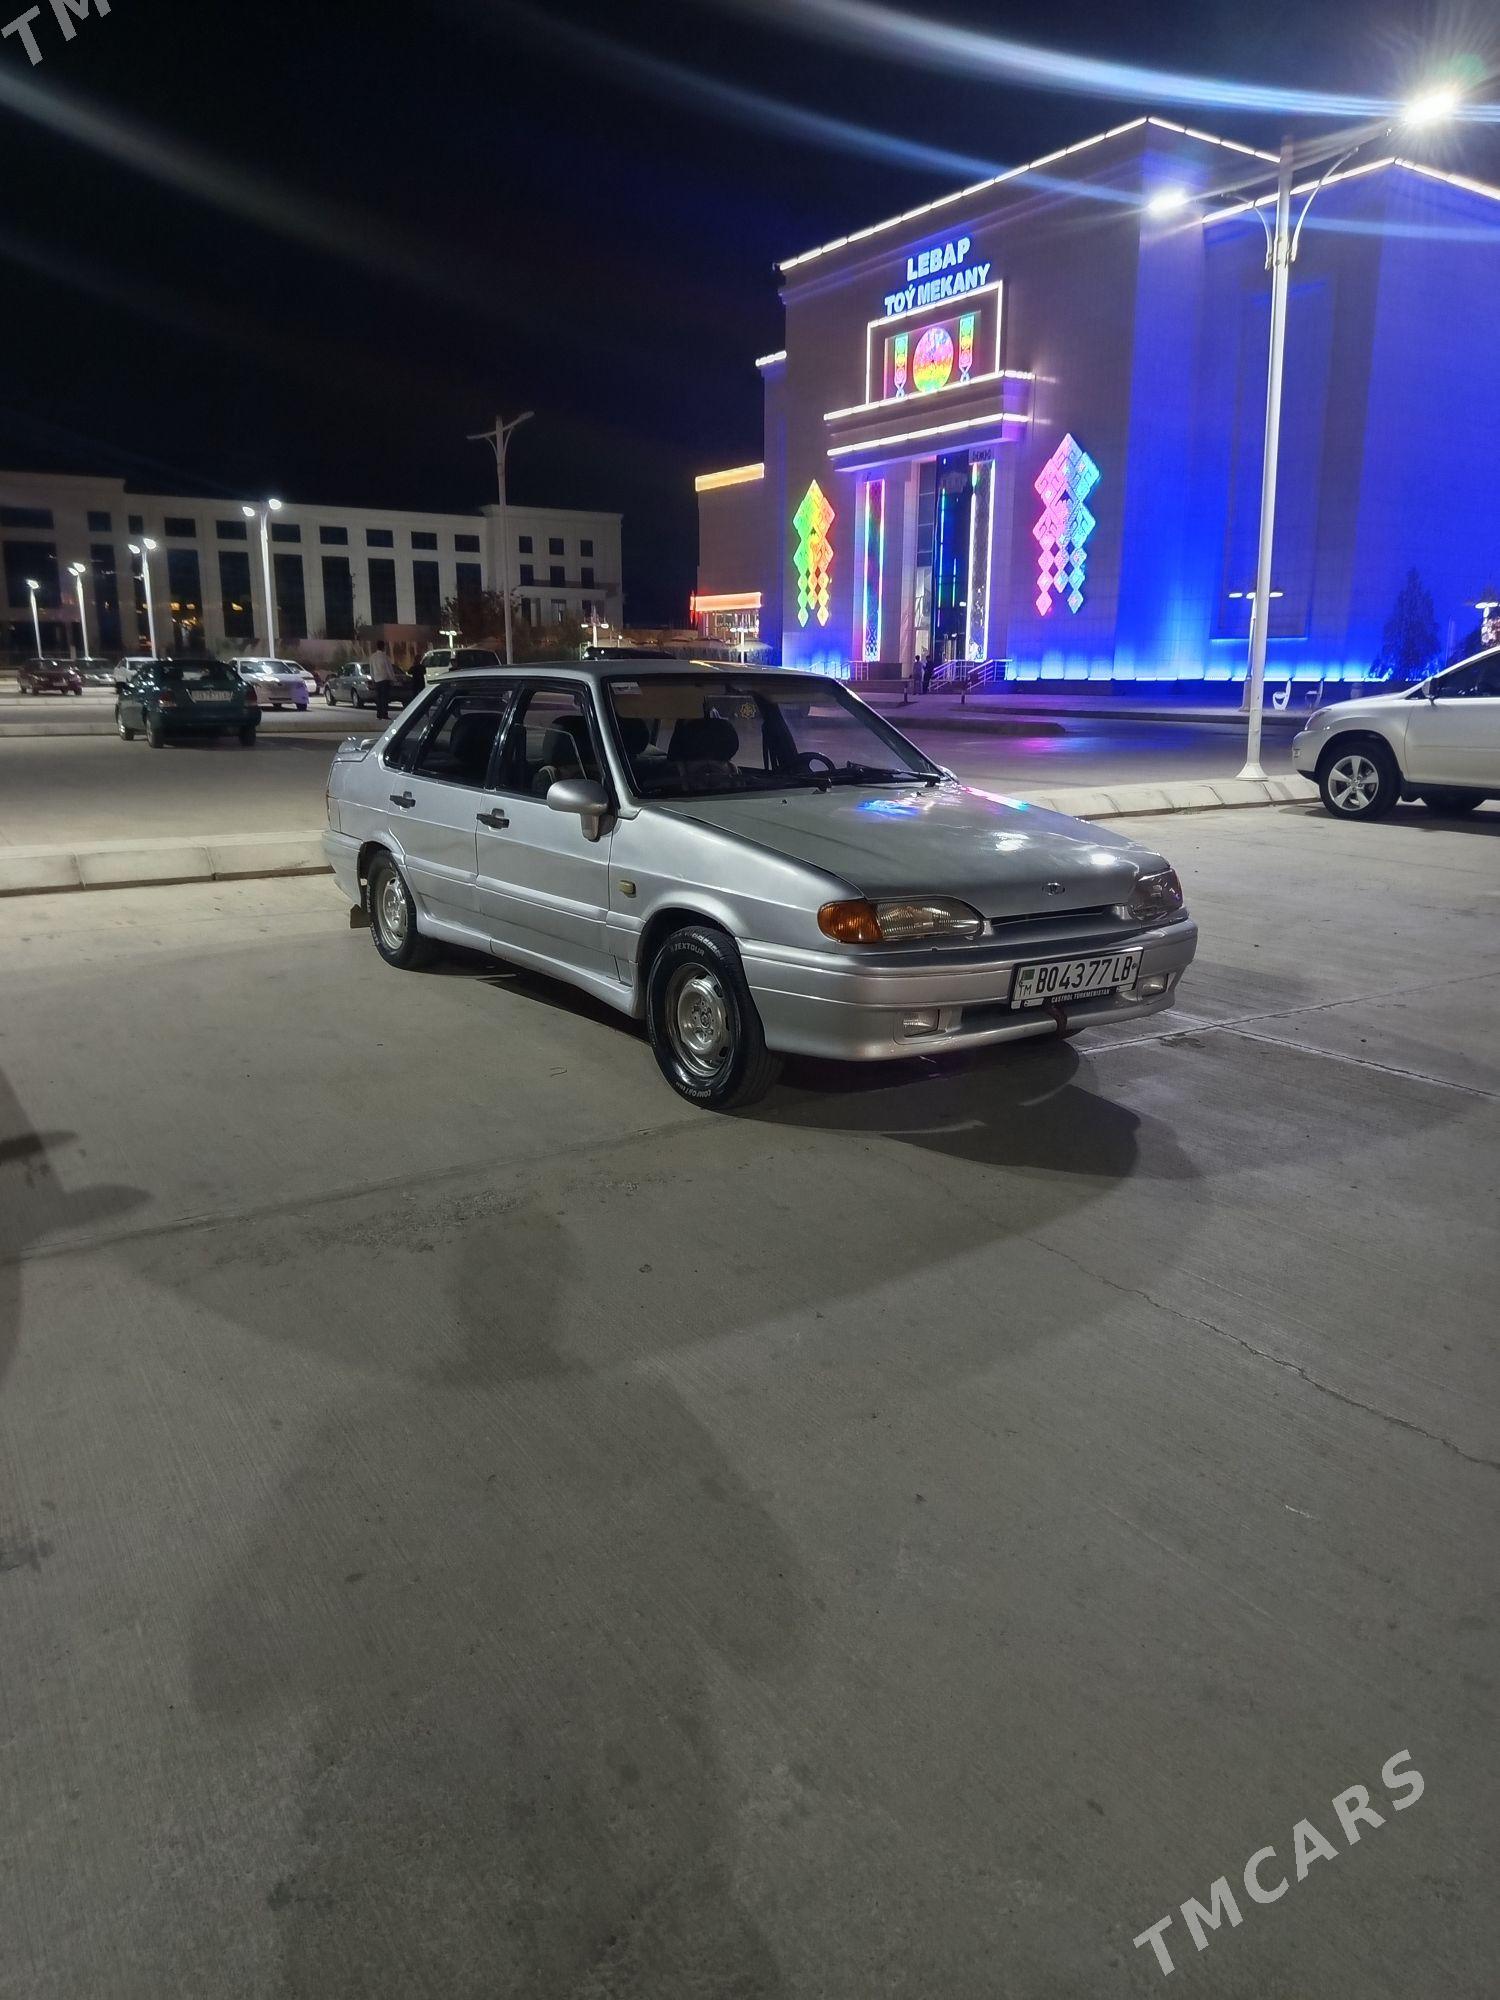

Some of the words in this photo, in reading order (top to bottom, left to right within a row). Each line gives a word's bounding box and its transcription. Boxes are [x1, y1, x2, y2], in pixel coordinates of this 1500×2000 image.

[907, 237, 971, 281] LEBAP
[884, 284, 915, 316] TOÝ
[917, 262, 991, 305] MEKANY
[1018, 983, 1032, 997] TM
